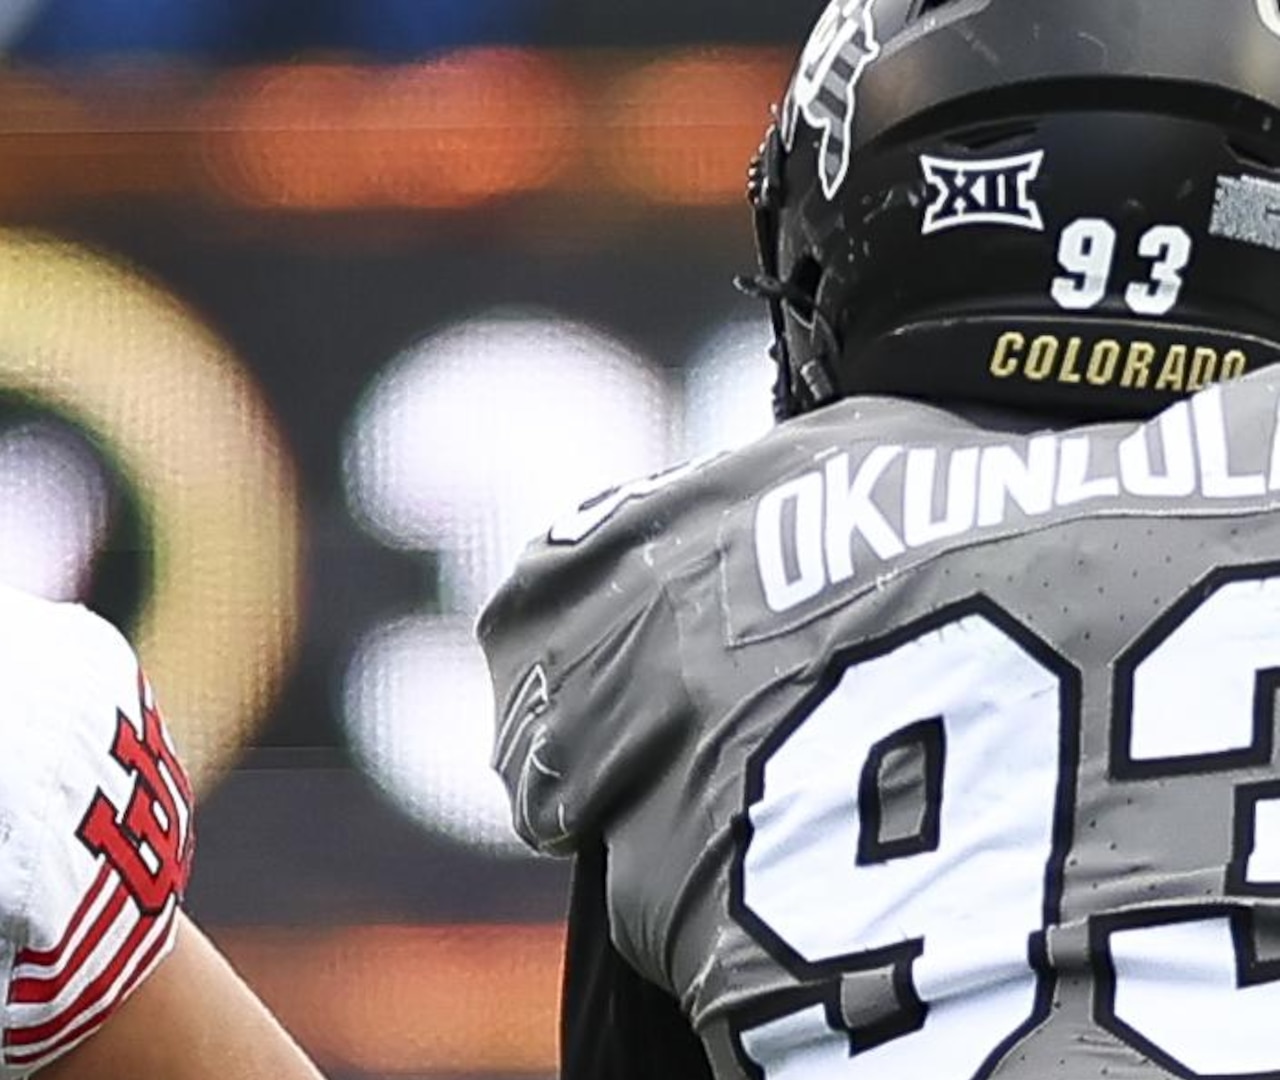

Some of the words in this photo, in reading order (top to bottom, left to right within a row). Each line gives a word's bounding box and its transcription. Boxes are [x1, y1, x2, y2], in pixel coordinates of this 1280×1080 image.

[1050, 217, 1192, 315] 93
[990, 331, 1248, 391] COLORADO
[754, 384, 1280, 612] OKUNLOL
